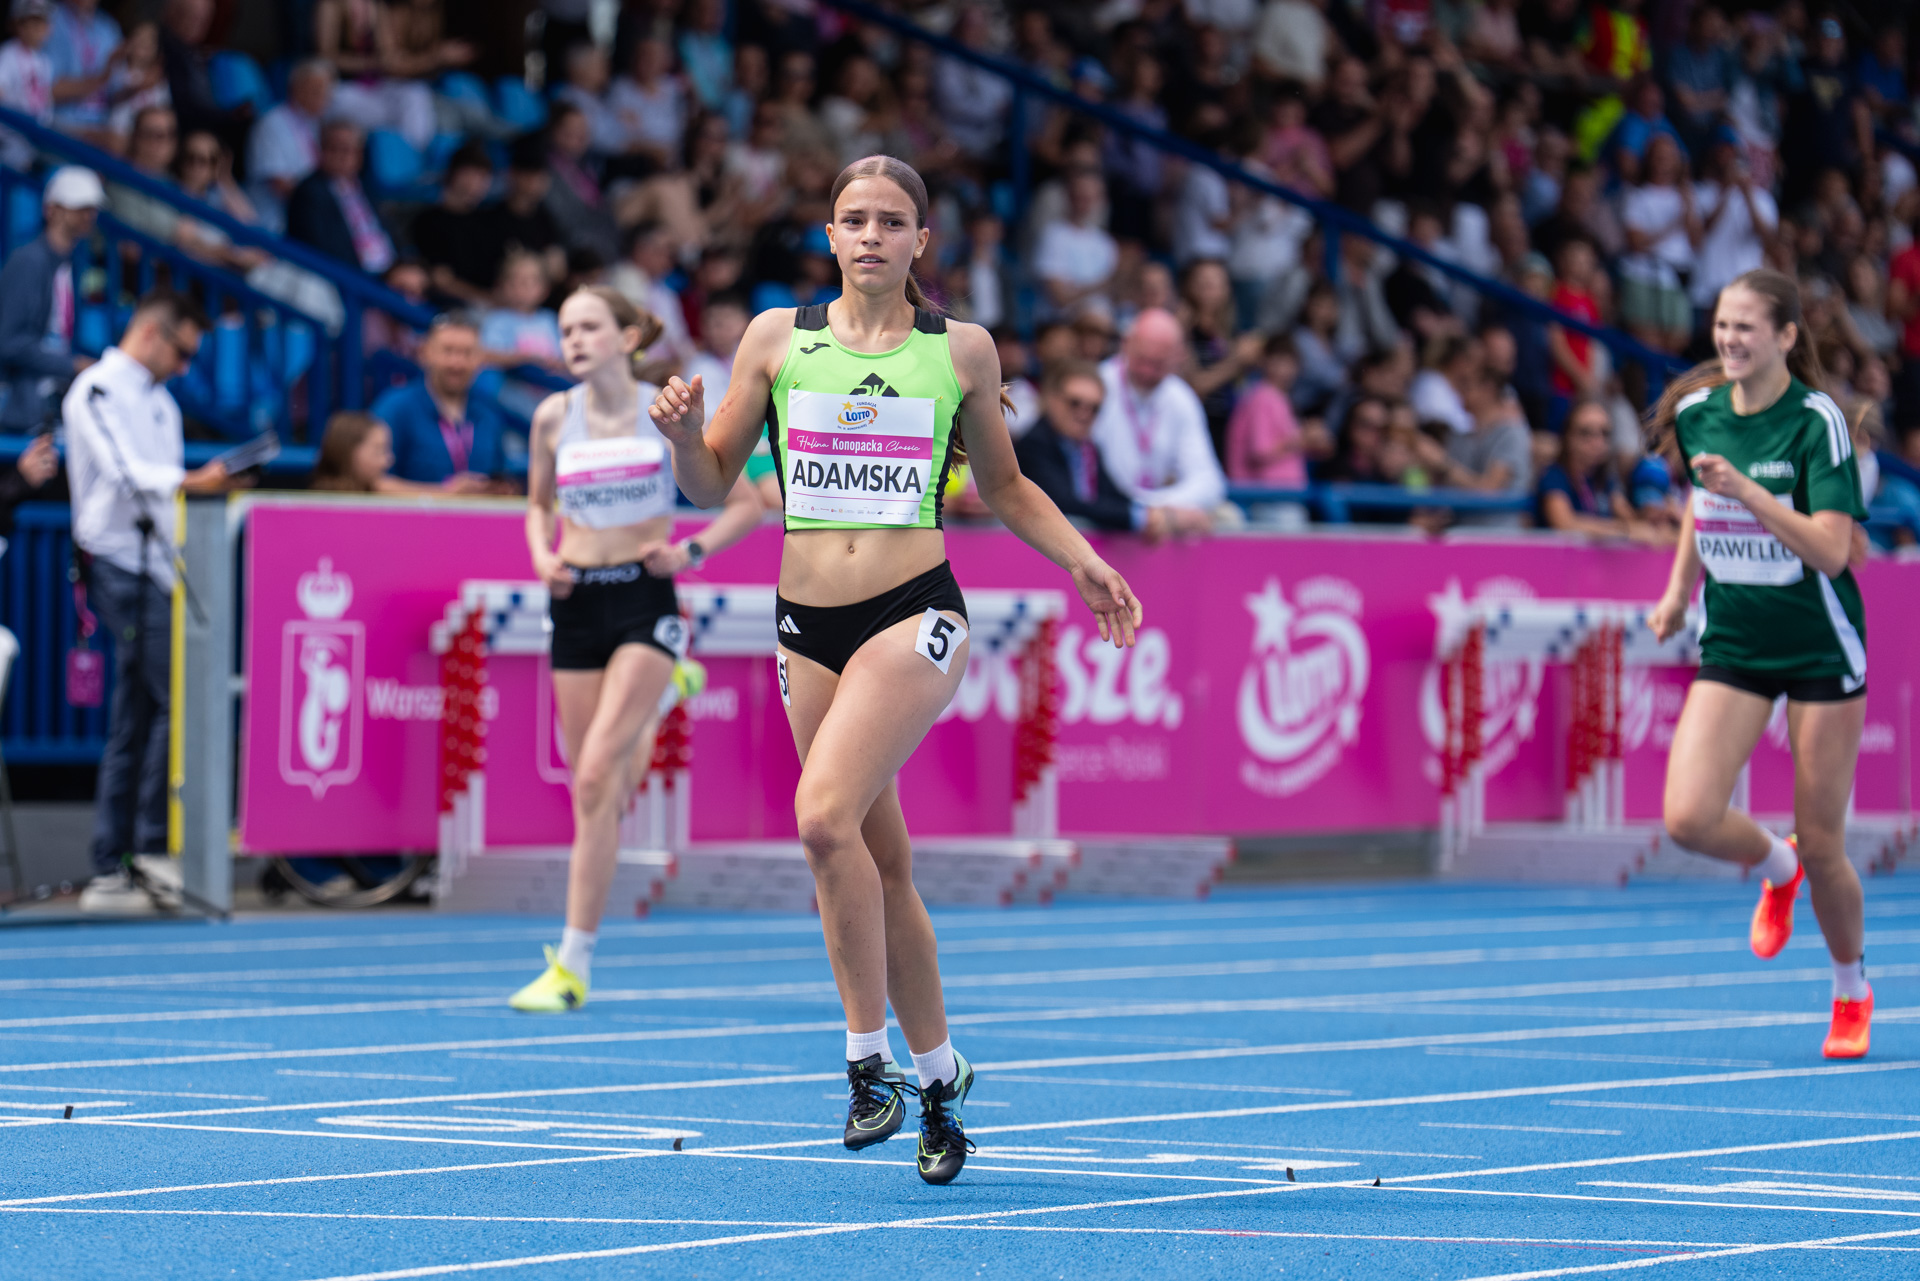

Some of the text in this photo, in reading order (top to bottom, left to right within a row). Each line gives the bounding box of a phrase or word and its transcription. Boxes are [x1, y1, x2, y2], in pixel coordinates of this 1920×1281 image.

[845, 410, 870, 422] LOTTO
[797, 435, 921, 453] Halina Konopacka Classic
[791, 458, 922, 493] ADAMSKA
[927, 617, 957, 661] 5
[778, 661, 789, 697] 5
